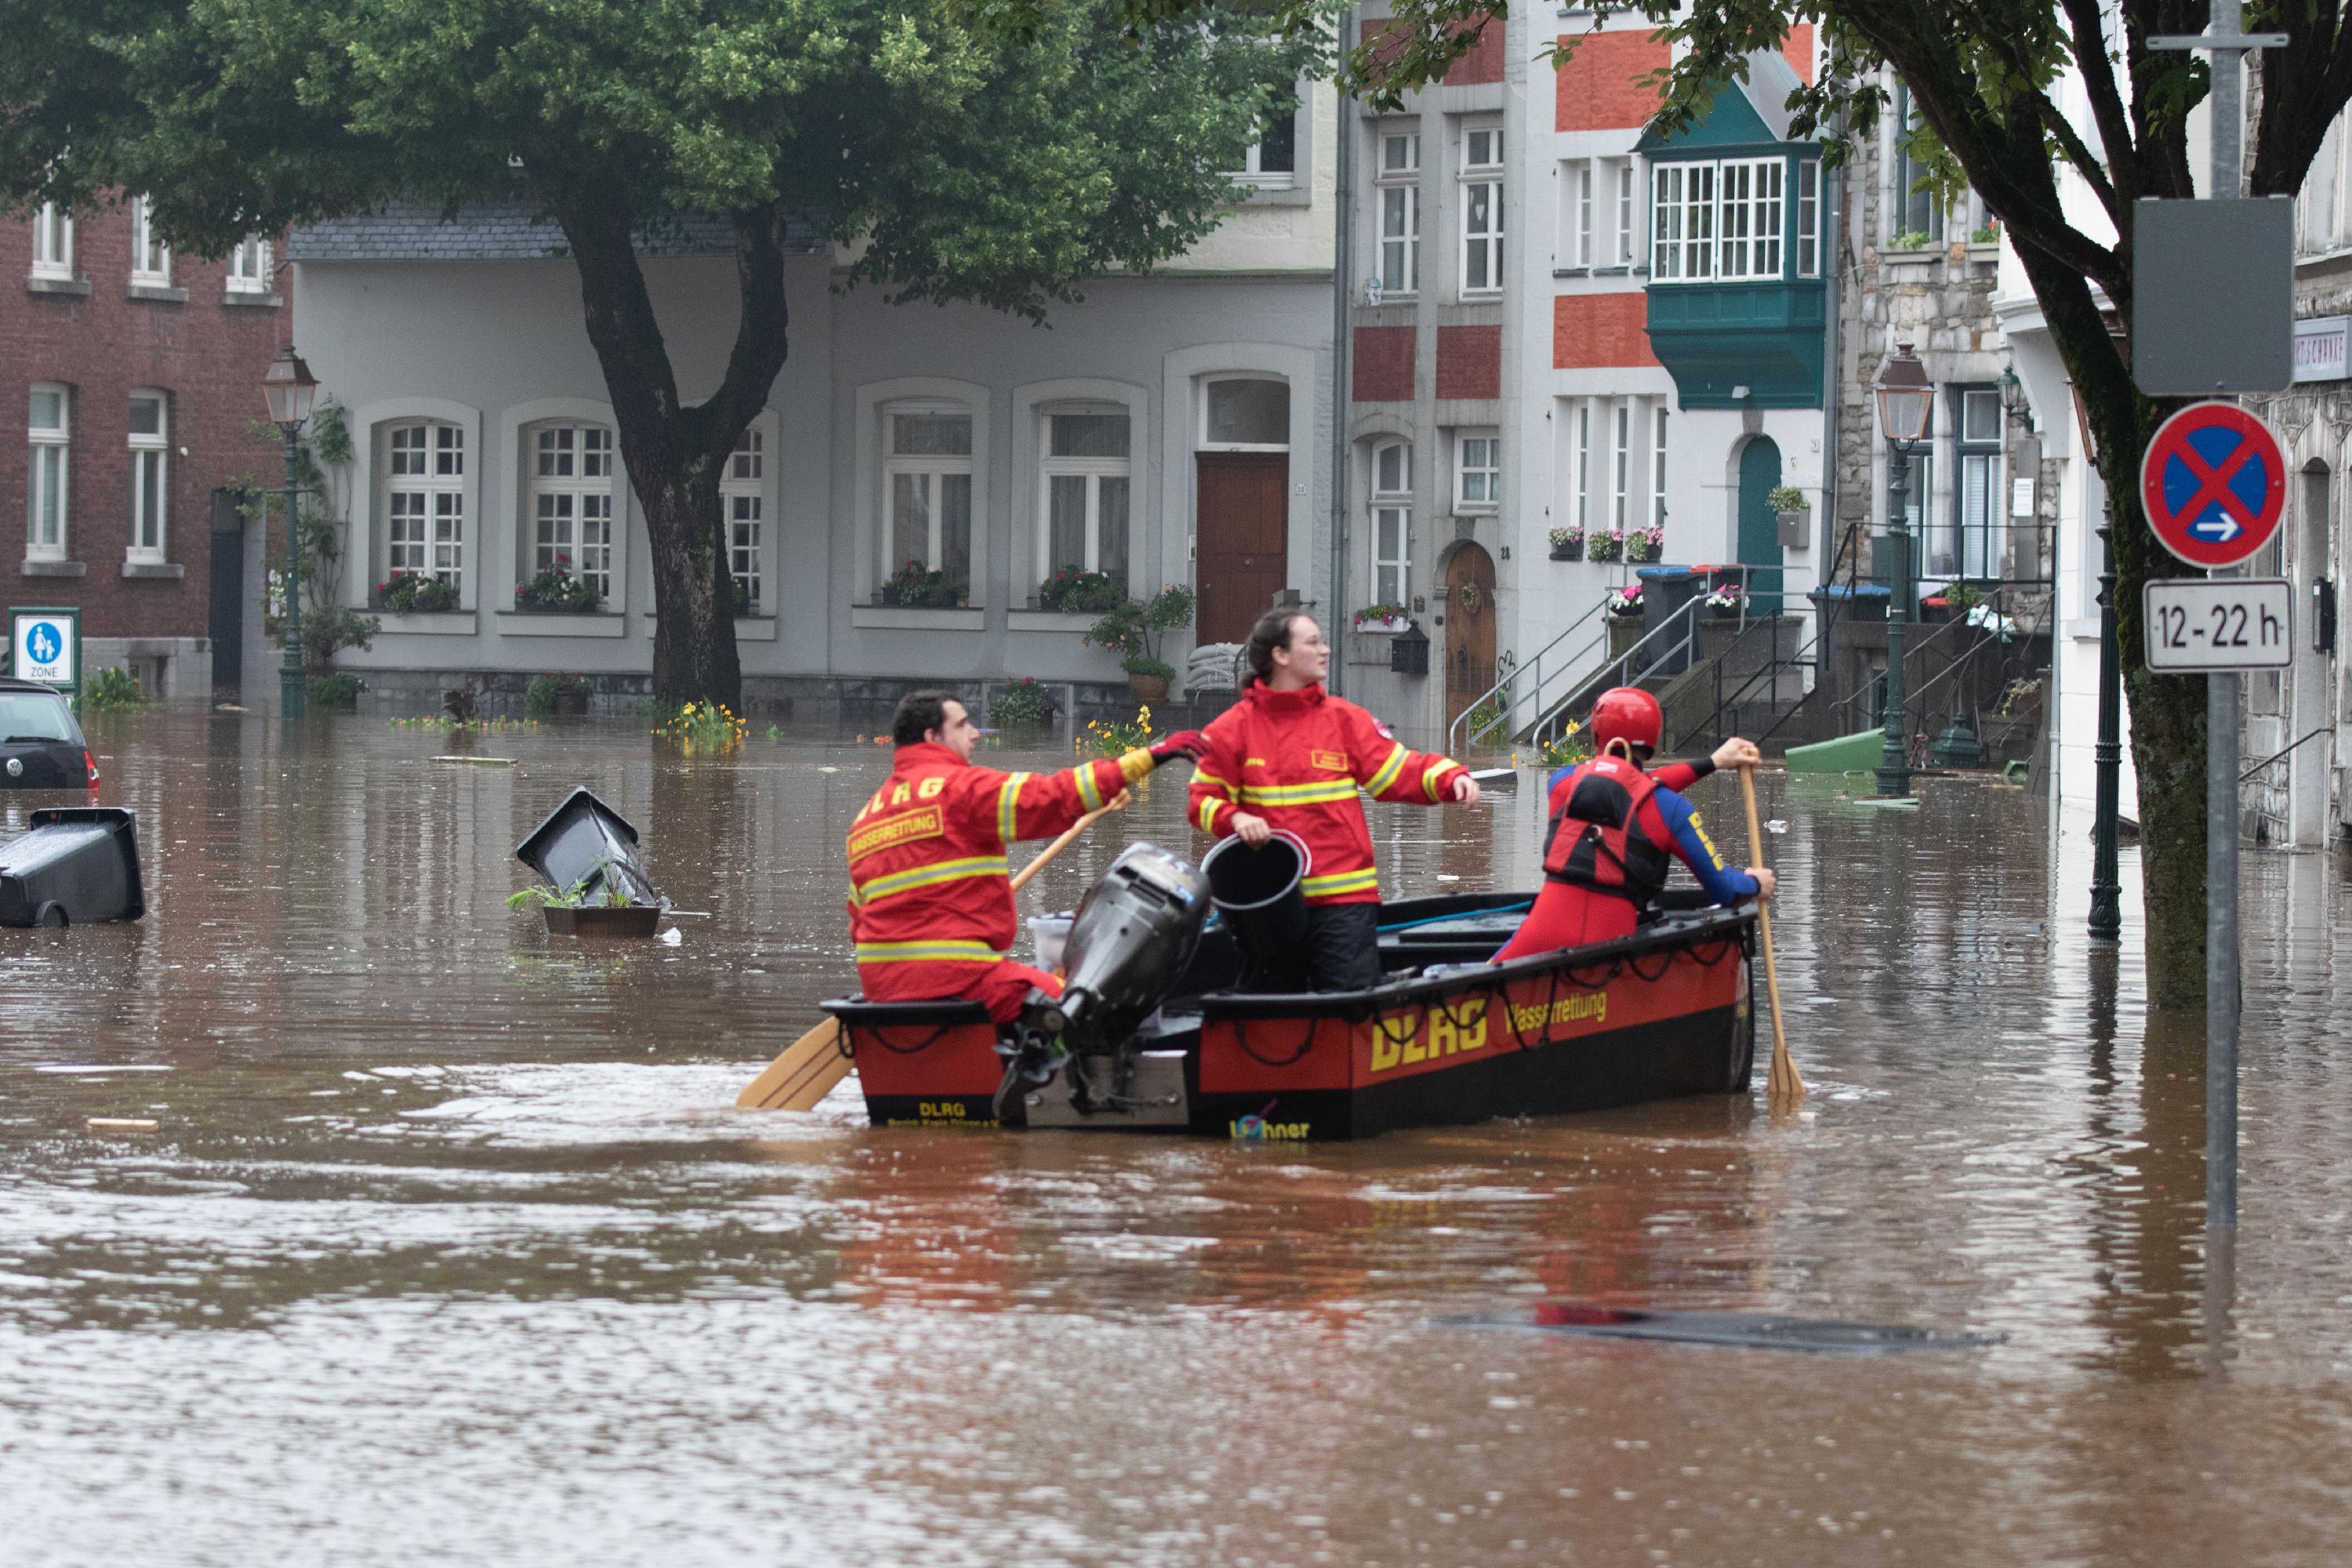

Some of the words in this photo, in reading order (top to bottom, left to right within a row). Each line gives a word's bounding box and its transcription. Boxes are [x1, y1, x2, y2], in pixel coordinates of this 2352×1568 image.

[1500, 546, 1510, 560] 28
[2259, 603, 2278, 646] h
[31, 666, 58, 677] ZONE
[853, 777, 946, 822] LRG
[1371, 998, 1487, 1072] DLRG
[920, 1102, 966, 1116] DLRG
